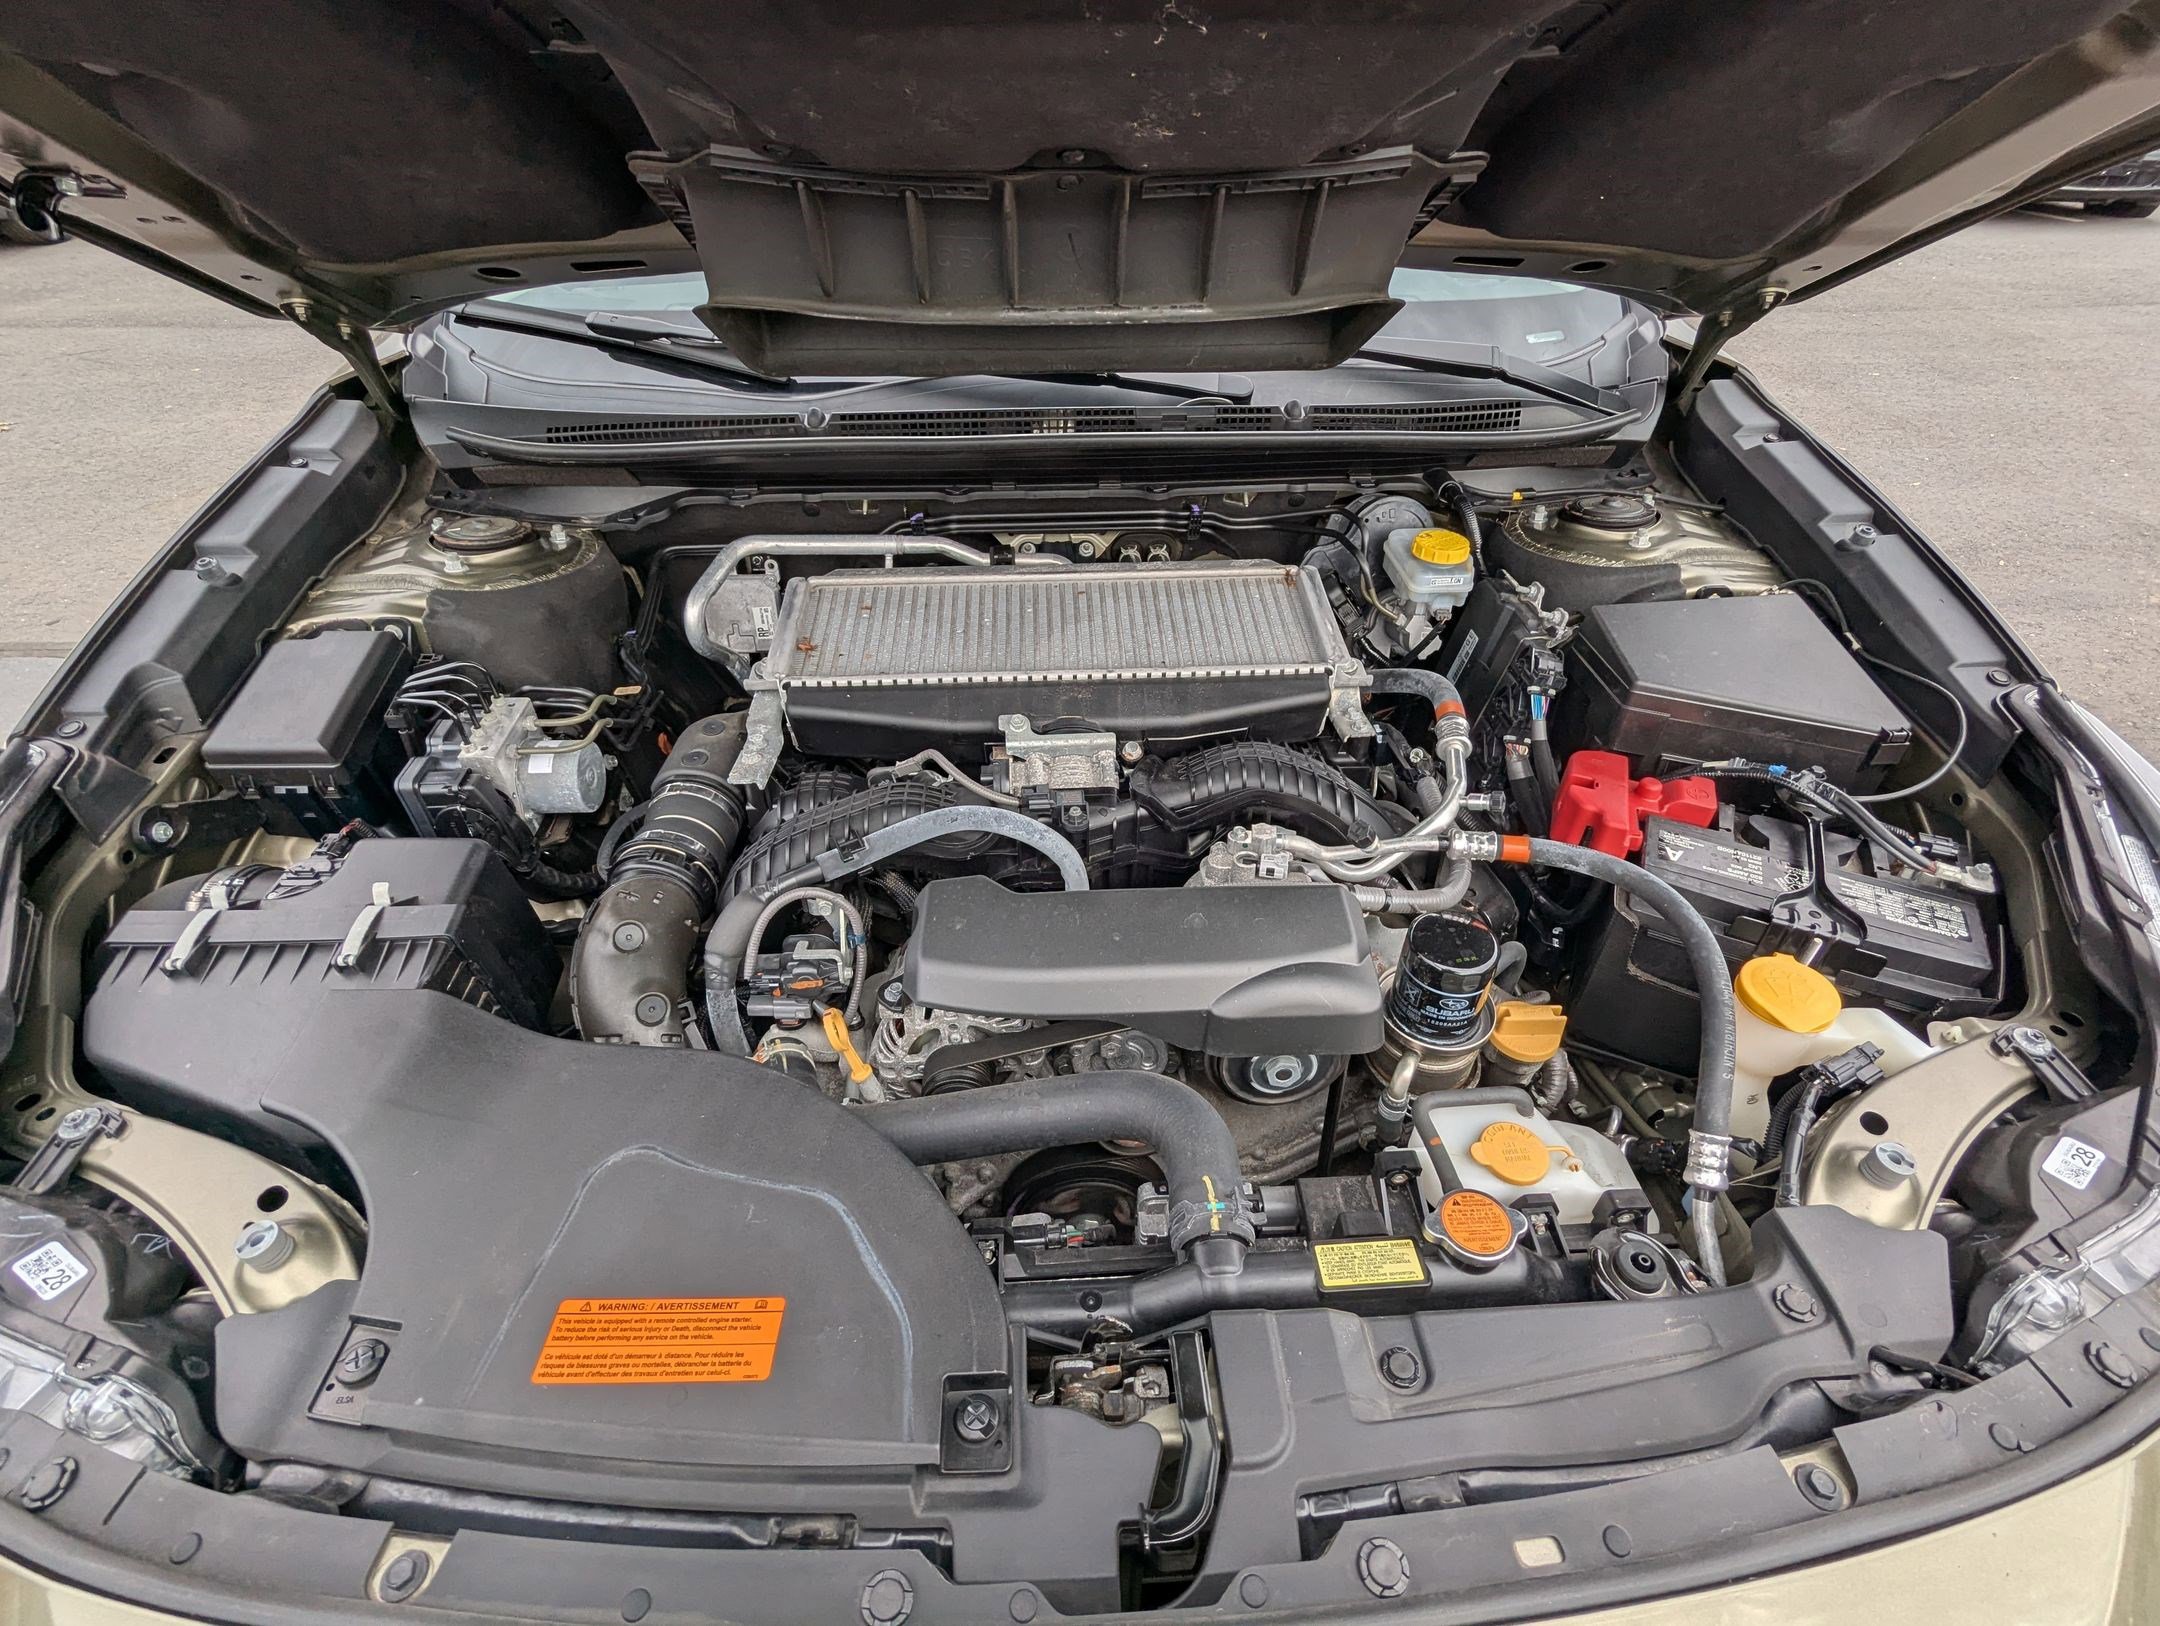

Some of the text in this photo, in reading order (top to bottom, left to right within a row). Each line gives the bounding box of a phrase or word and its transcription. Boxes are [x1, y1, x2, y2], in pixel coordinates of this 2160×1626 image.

[757, 627, 770, 638] RP
[1425, 1004, 1476, 1017] SUBARU
[2071, 1146, 2096, 1167] 28
[41, 1268, 72, 1291] 28
[598, 1302, 649, 1311] WARNING:
[656, 1301, 740, 1311] AVERTISSEMENT
[604, 1318, 632, 1326] equipped
[708, 1317, 730, 1325] engine
[596, 1334, 631, 1342] performing
